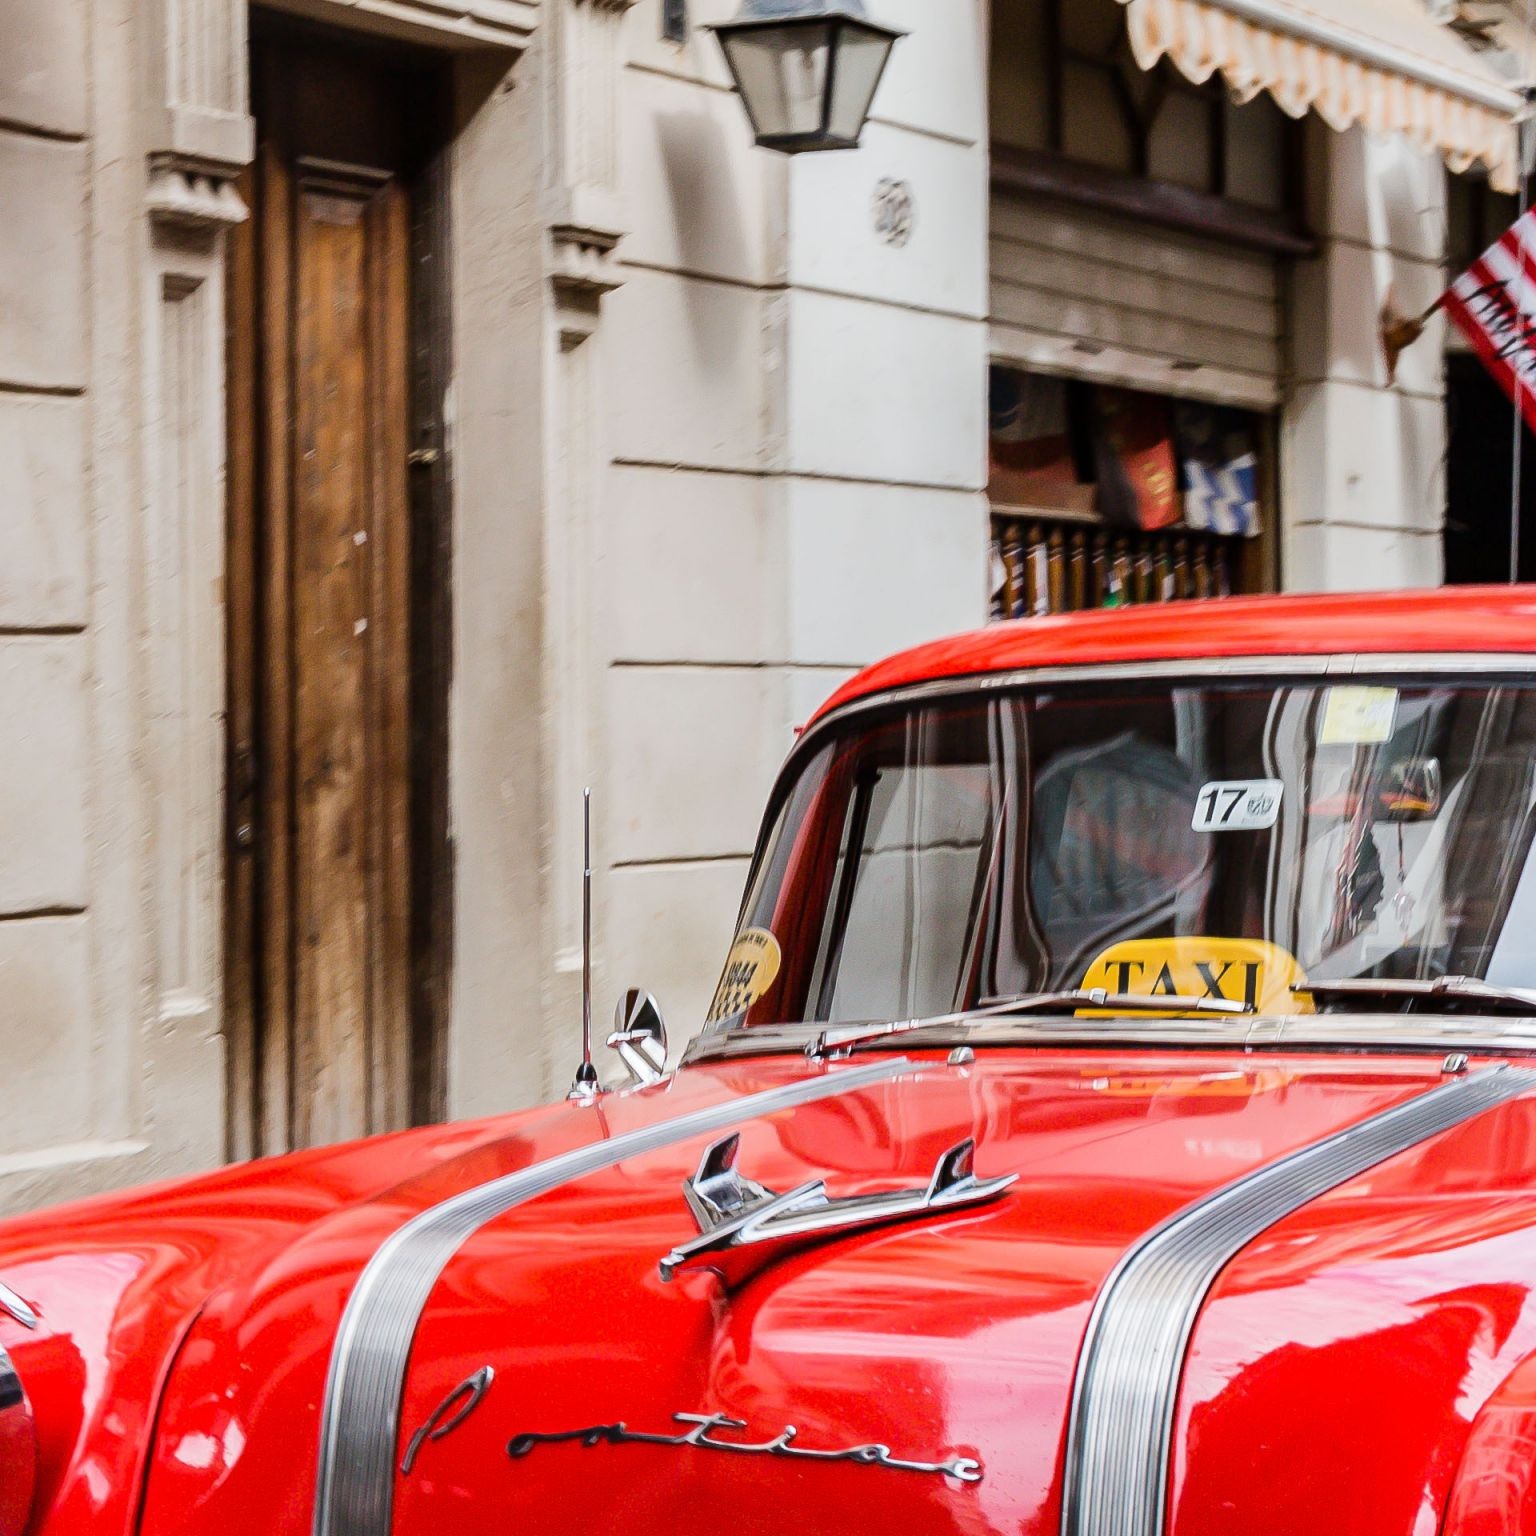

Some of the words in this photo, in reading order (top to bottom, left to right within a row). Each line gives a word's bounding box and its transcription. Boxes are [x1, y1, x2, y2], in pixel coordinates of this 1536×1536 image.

[1201, 787, 1249, 825] 17
[1104, 959, 1264, 1013] TAXI
[401, 1365, 984, 1483] Pontiac
